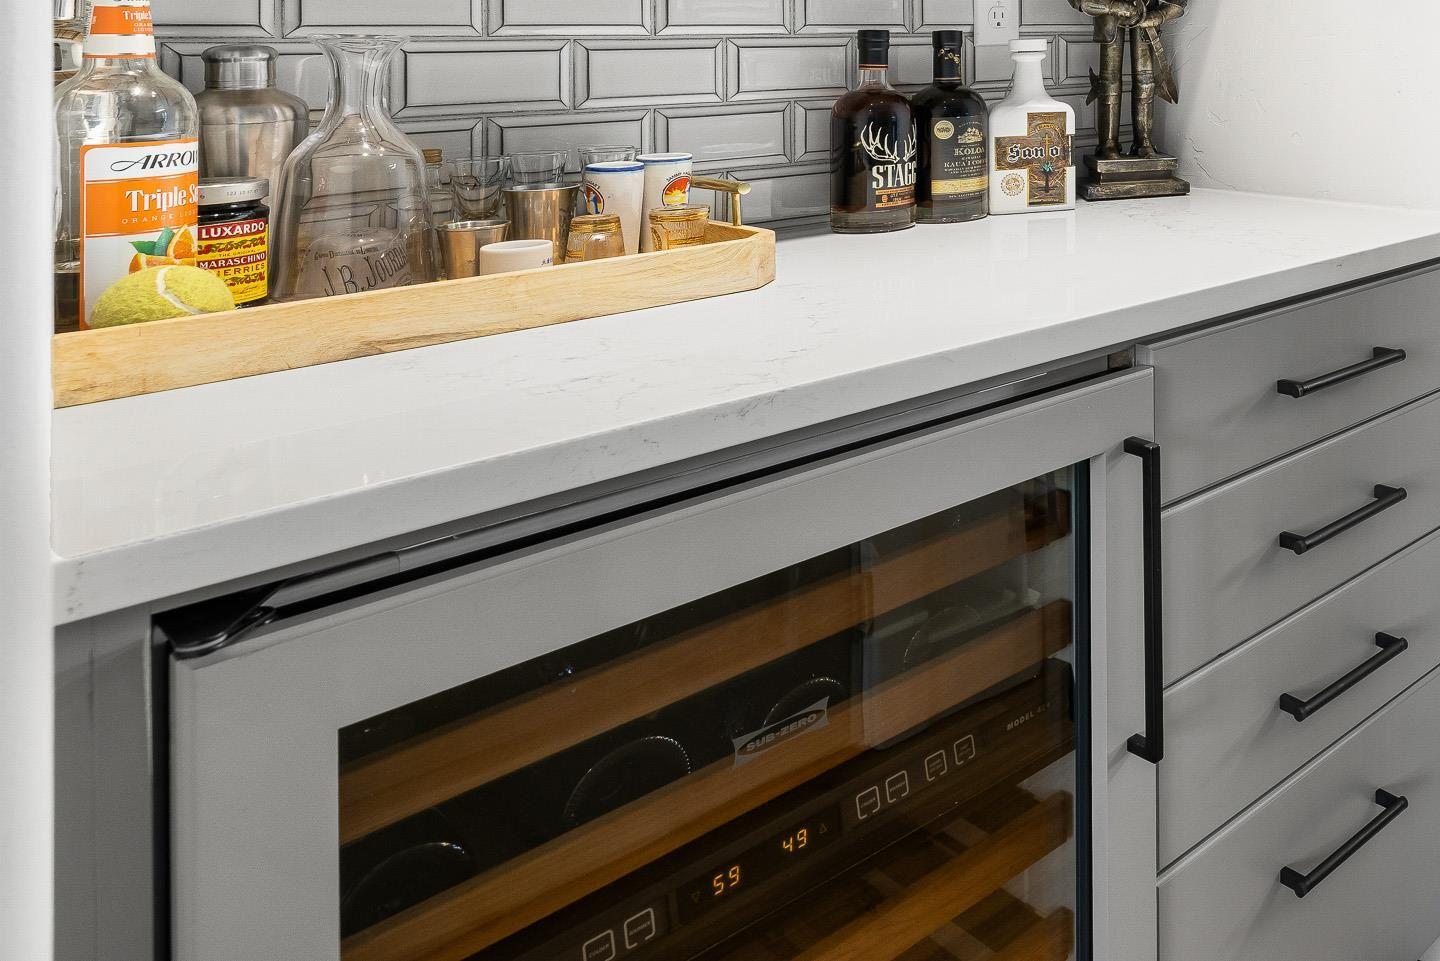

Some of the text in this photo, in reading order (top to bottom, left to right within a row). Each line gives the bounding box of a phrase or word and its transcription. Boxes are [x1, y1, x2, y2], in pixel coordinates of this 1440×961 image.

[871, 160, 917, 189] STAGG
[125, 185, 187, 212] Triple
[121, 213, 175, 224] ORANGE
[201, 221, 265, 239] LUXARDO
[199, 251, 266, 270] MARASCHINO
[746, 713, 818, 752] SUB-ZERO
[782, 827, 808, 853] 49
[712, 864, 741, 896] 59
